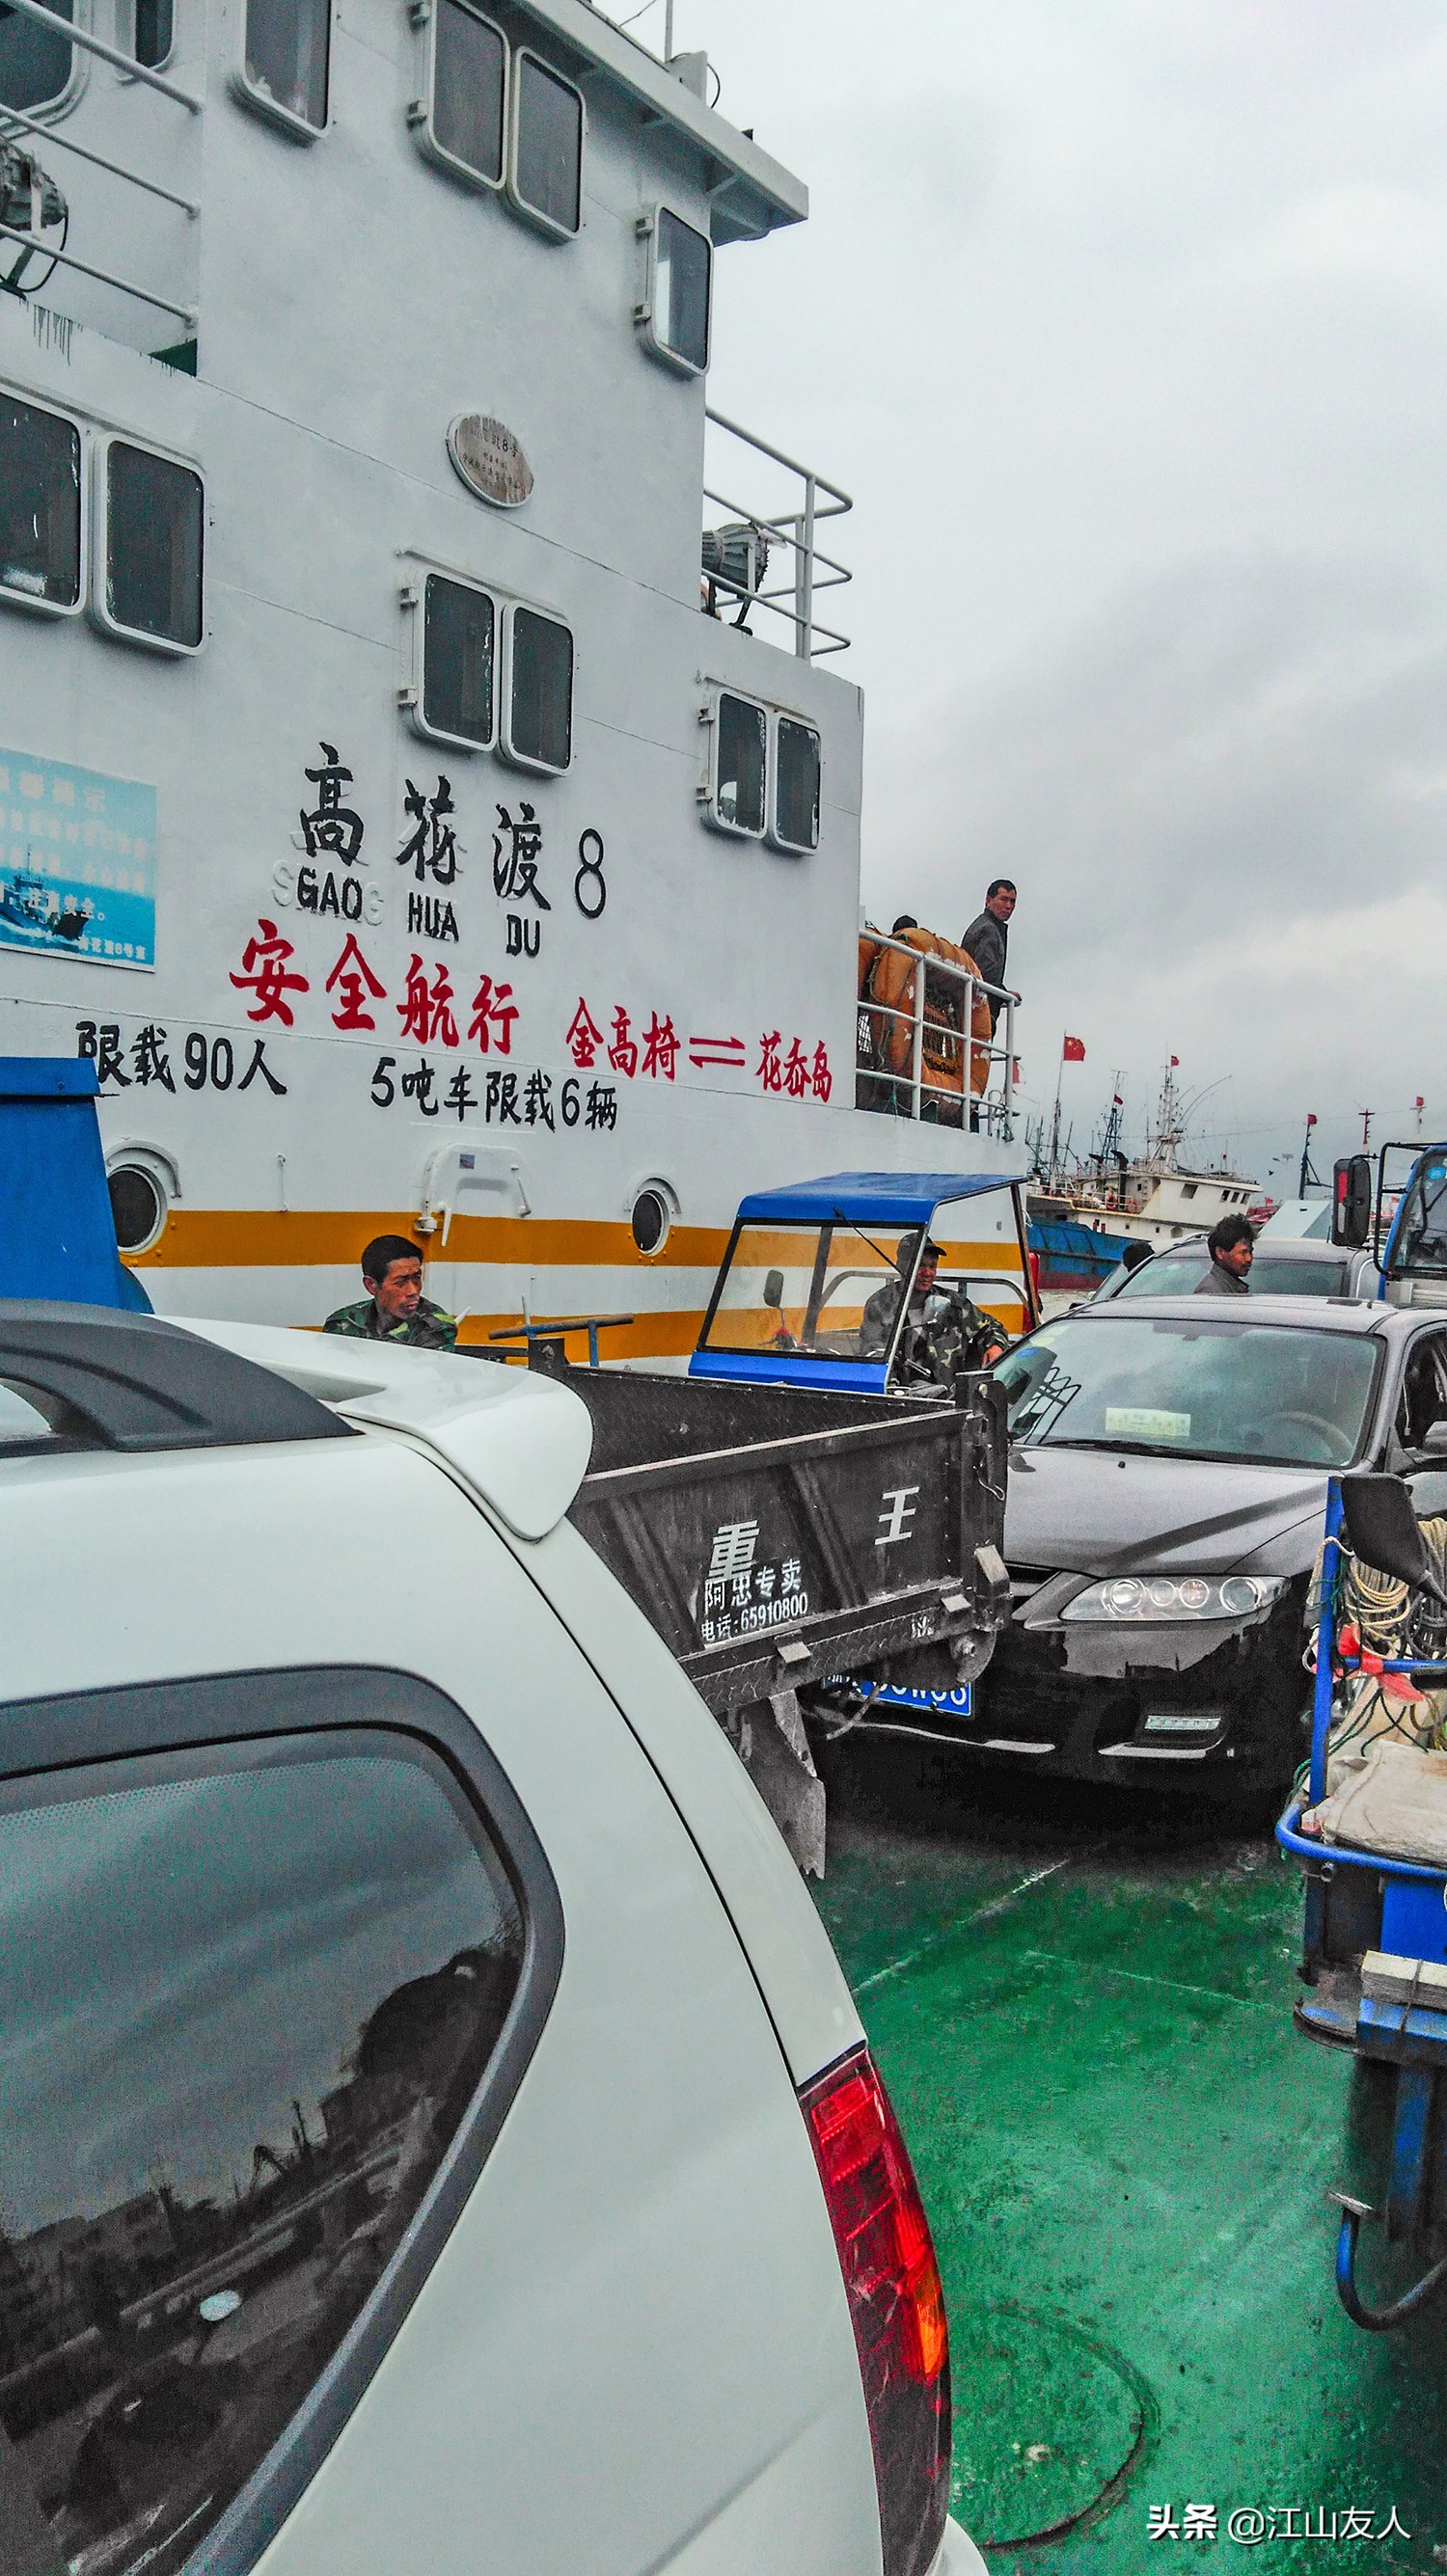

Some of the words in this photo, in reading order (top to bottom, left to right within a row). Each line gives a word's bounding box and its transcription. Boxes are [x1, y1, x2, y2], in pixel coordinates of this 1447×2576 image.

[296, 866, 364, 921] GAO
[407, 891, 460, 944] HUA
[505, 913, 541, 959] DU
[229, 918, 520, 1056] 安全航行
[75, 1020, 288, 1096] 限载90人
[369, 1056, 618, 1134] 5吨车限载6辆
[704, 1519, 760, 1584] 重
[873, 1486, 920, 1545] 王
